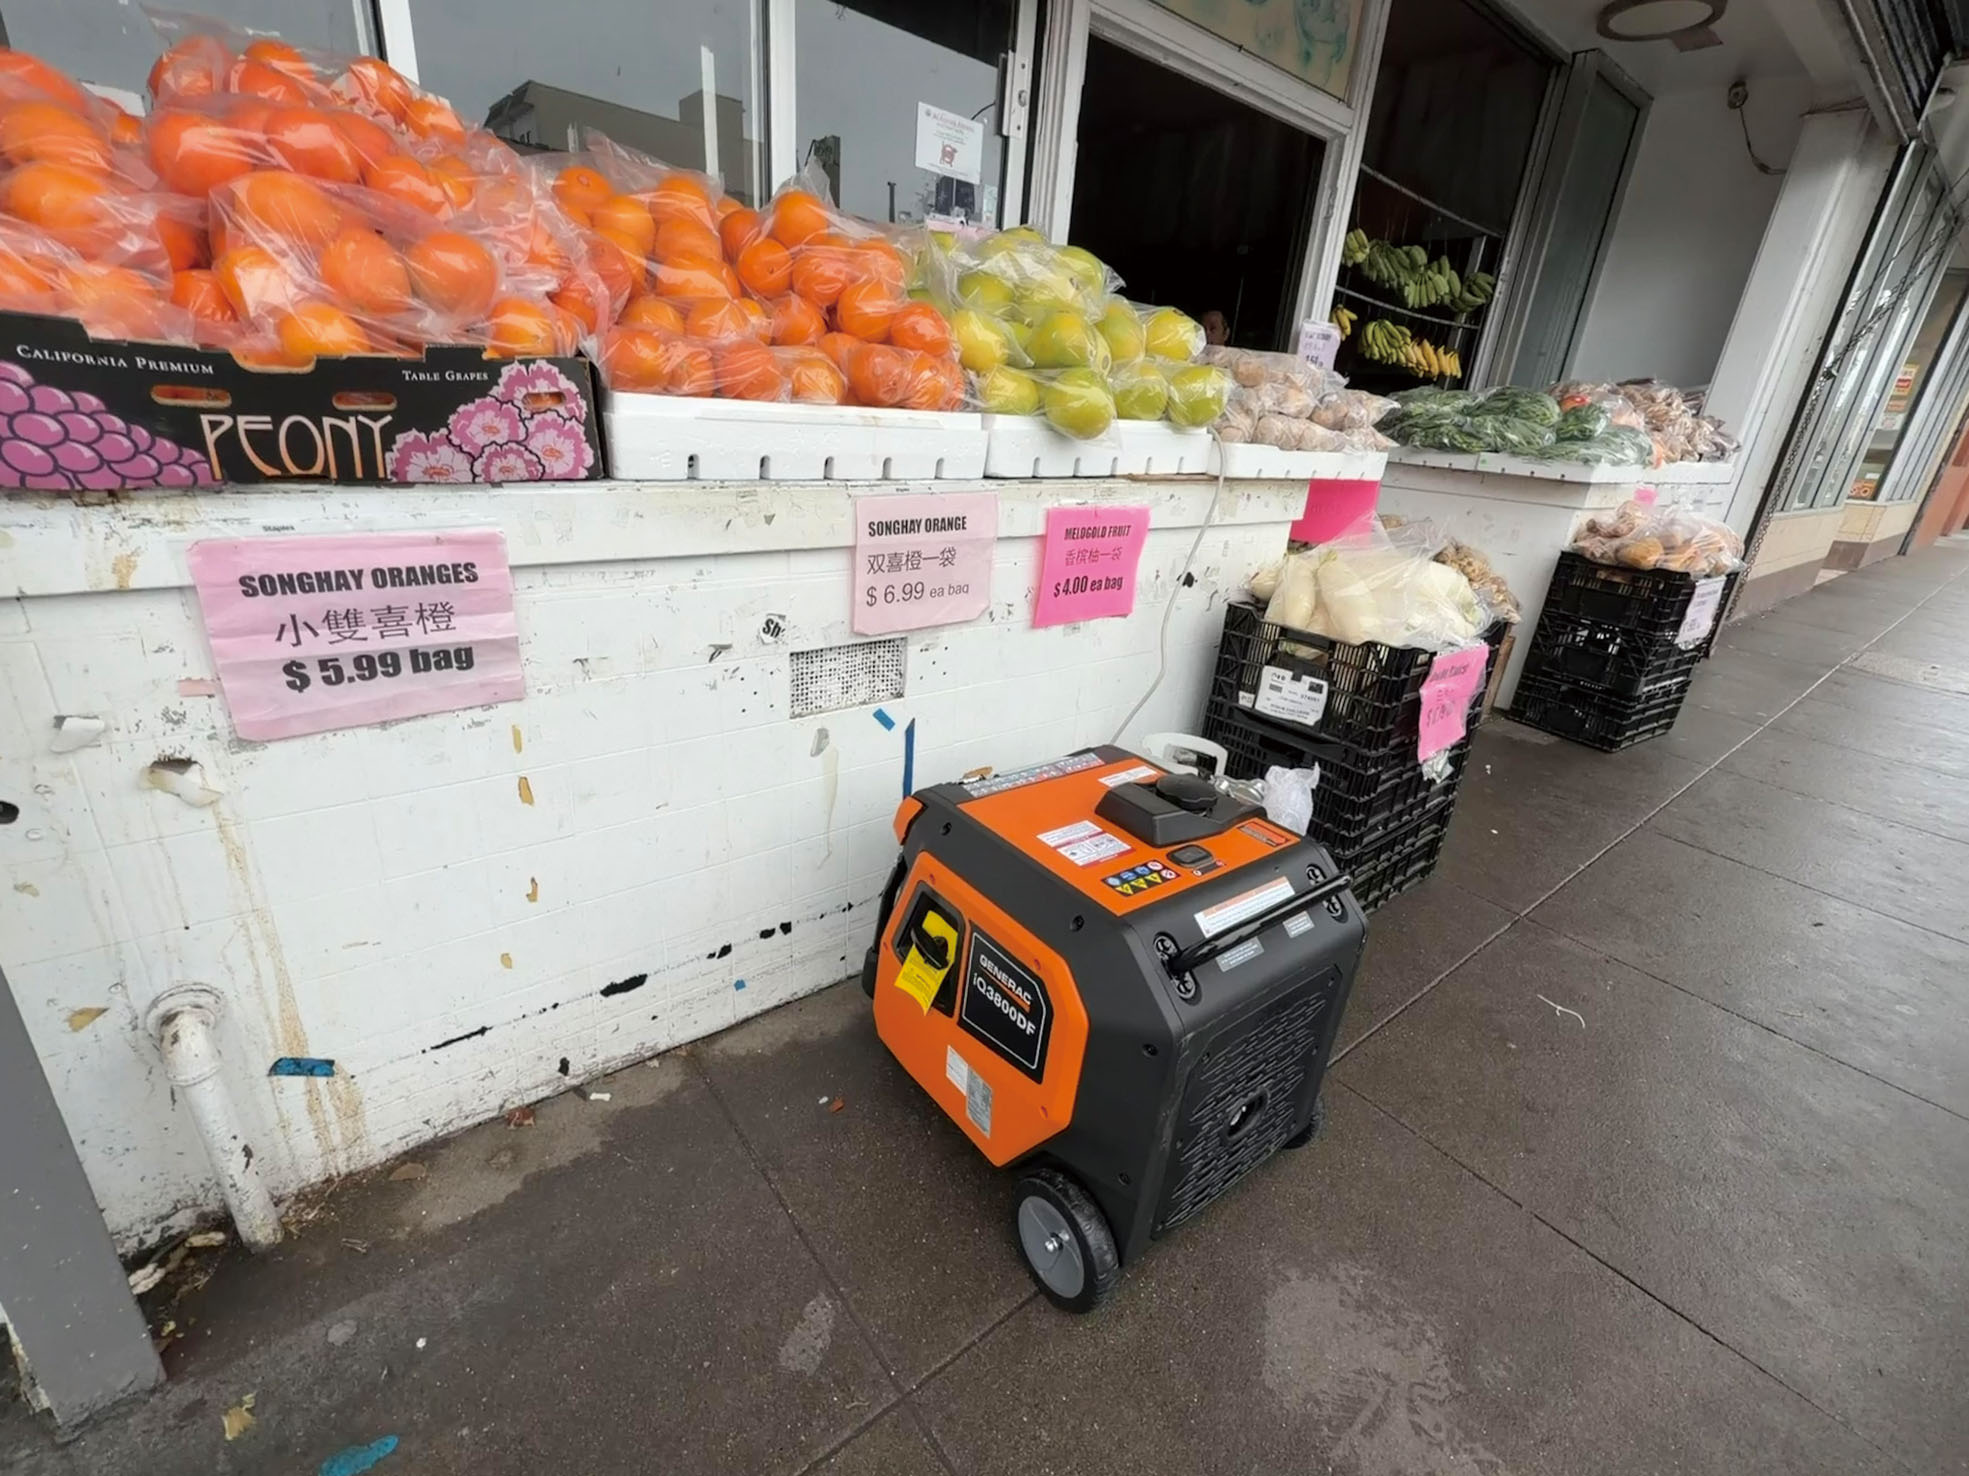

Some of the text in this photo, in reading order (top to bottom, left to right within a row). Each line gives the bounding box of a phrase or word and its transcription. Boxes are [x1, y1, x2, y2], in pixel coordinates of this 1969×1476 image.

[16, 344, 214, 375] CALIFORNIA PREMIUM
[402, 370, 489, 381] TABLE GRAPES
[200, 413, 393, 480] PEONY
[868, 515, 967, 537] SONGHAY ORANGE
[1064, 525, 1132, 540] MELOGOLD FRUIT
[866, 547, 957, 575] 双喜橙一袋
[238, 561, 479, 598] SONGHAY ORANGES
[929, 586, 945, 599] ea
[948, 583, 969, 597] bag
[1090, 579, 1103, 592] ea
[1104, 576, 1123, 591] bag
[274, 600, 458, 648] 小雙喜橙
[409, 645, 475, 676] bag
[980, 954, 1032, 1006] GENERAC
[973, 972, 1036, 1036] iQ3800DF
